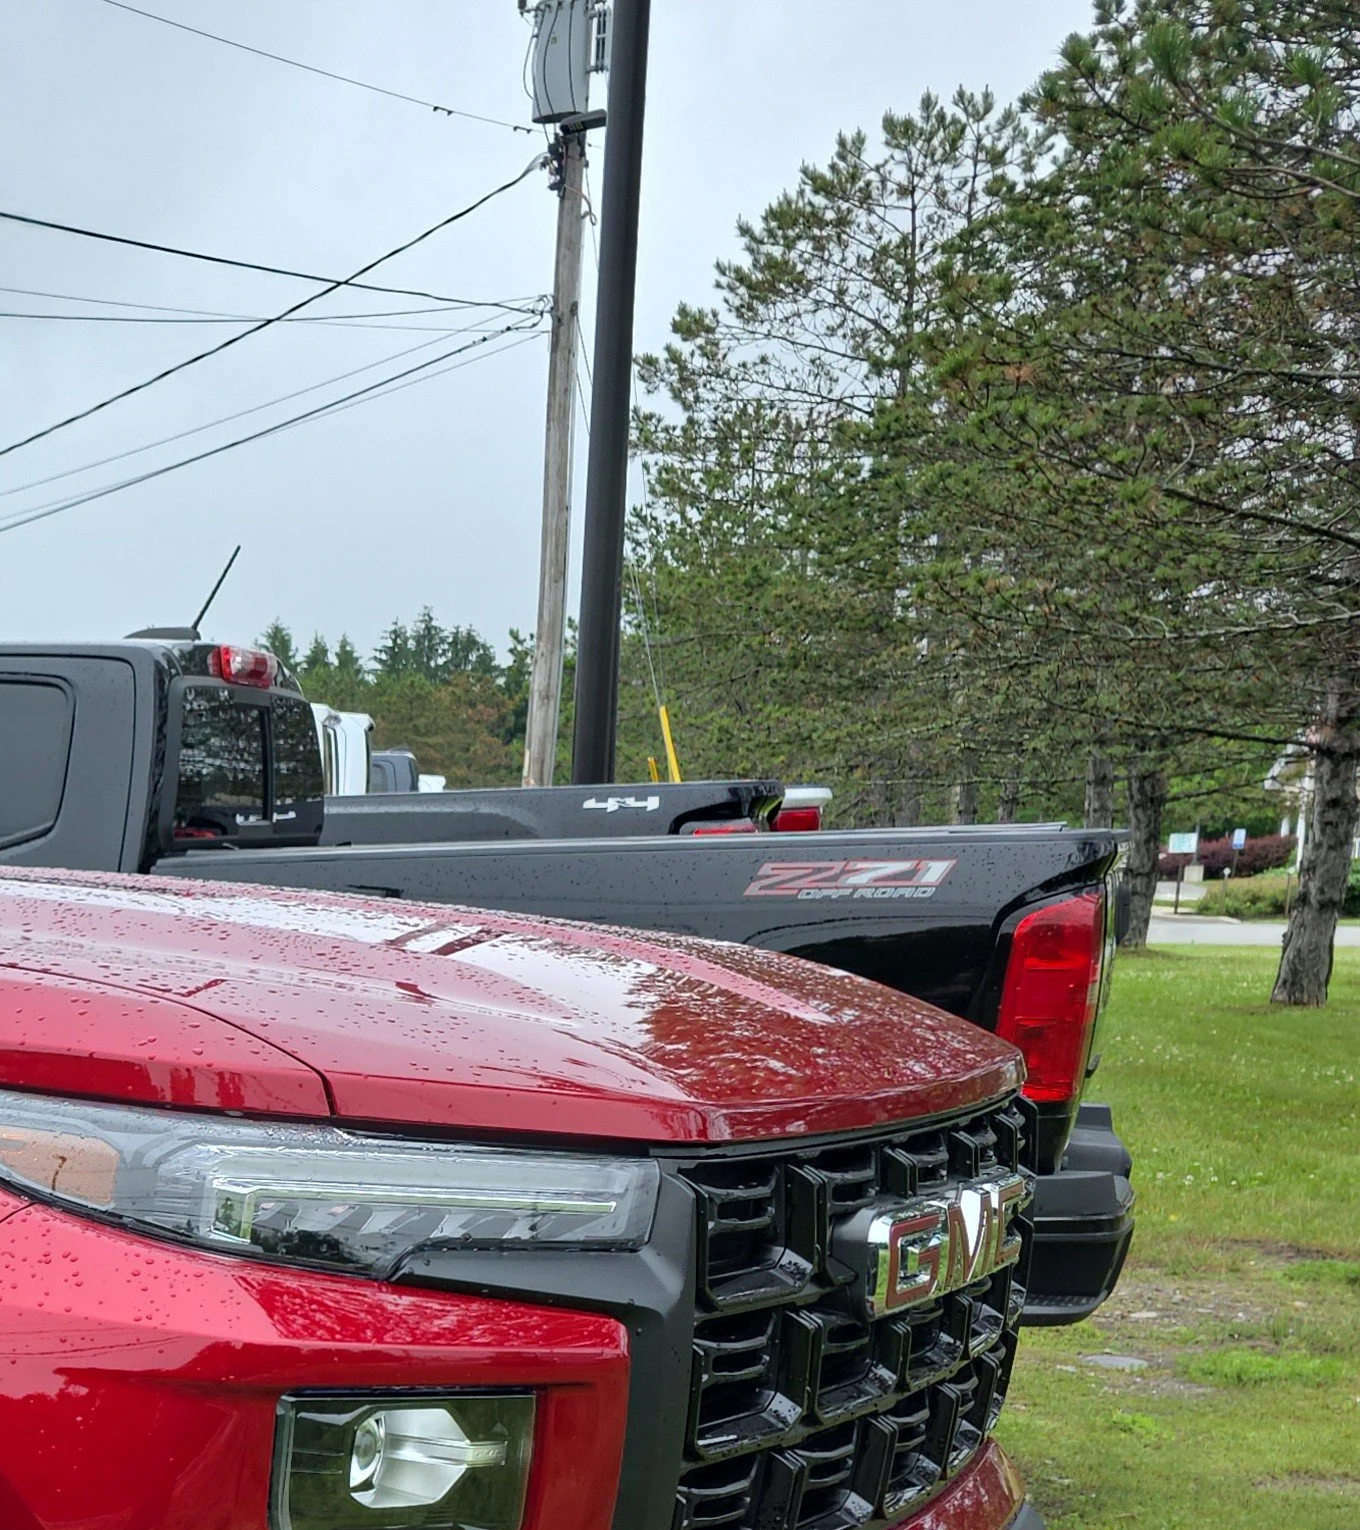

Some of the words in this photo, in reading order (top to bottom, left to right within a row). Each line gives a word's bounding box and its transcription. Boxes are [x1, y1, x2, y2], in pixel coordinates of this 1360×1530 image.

[743, 858, 958, 896] Z71
[797, 886, 854, 900] OFF
[853, 886, 936, 899] ROAD
[870, 1173, 1026, 1316] GMC
